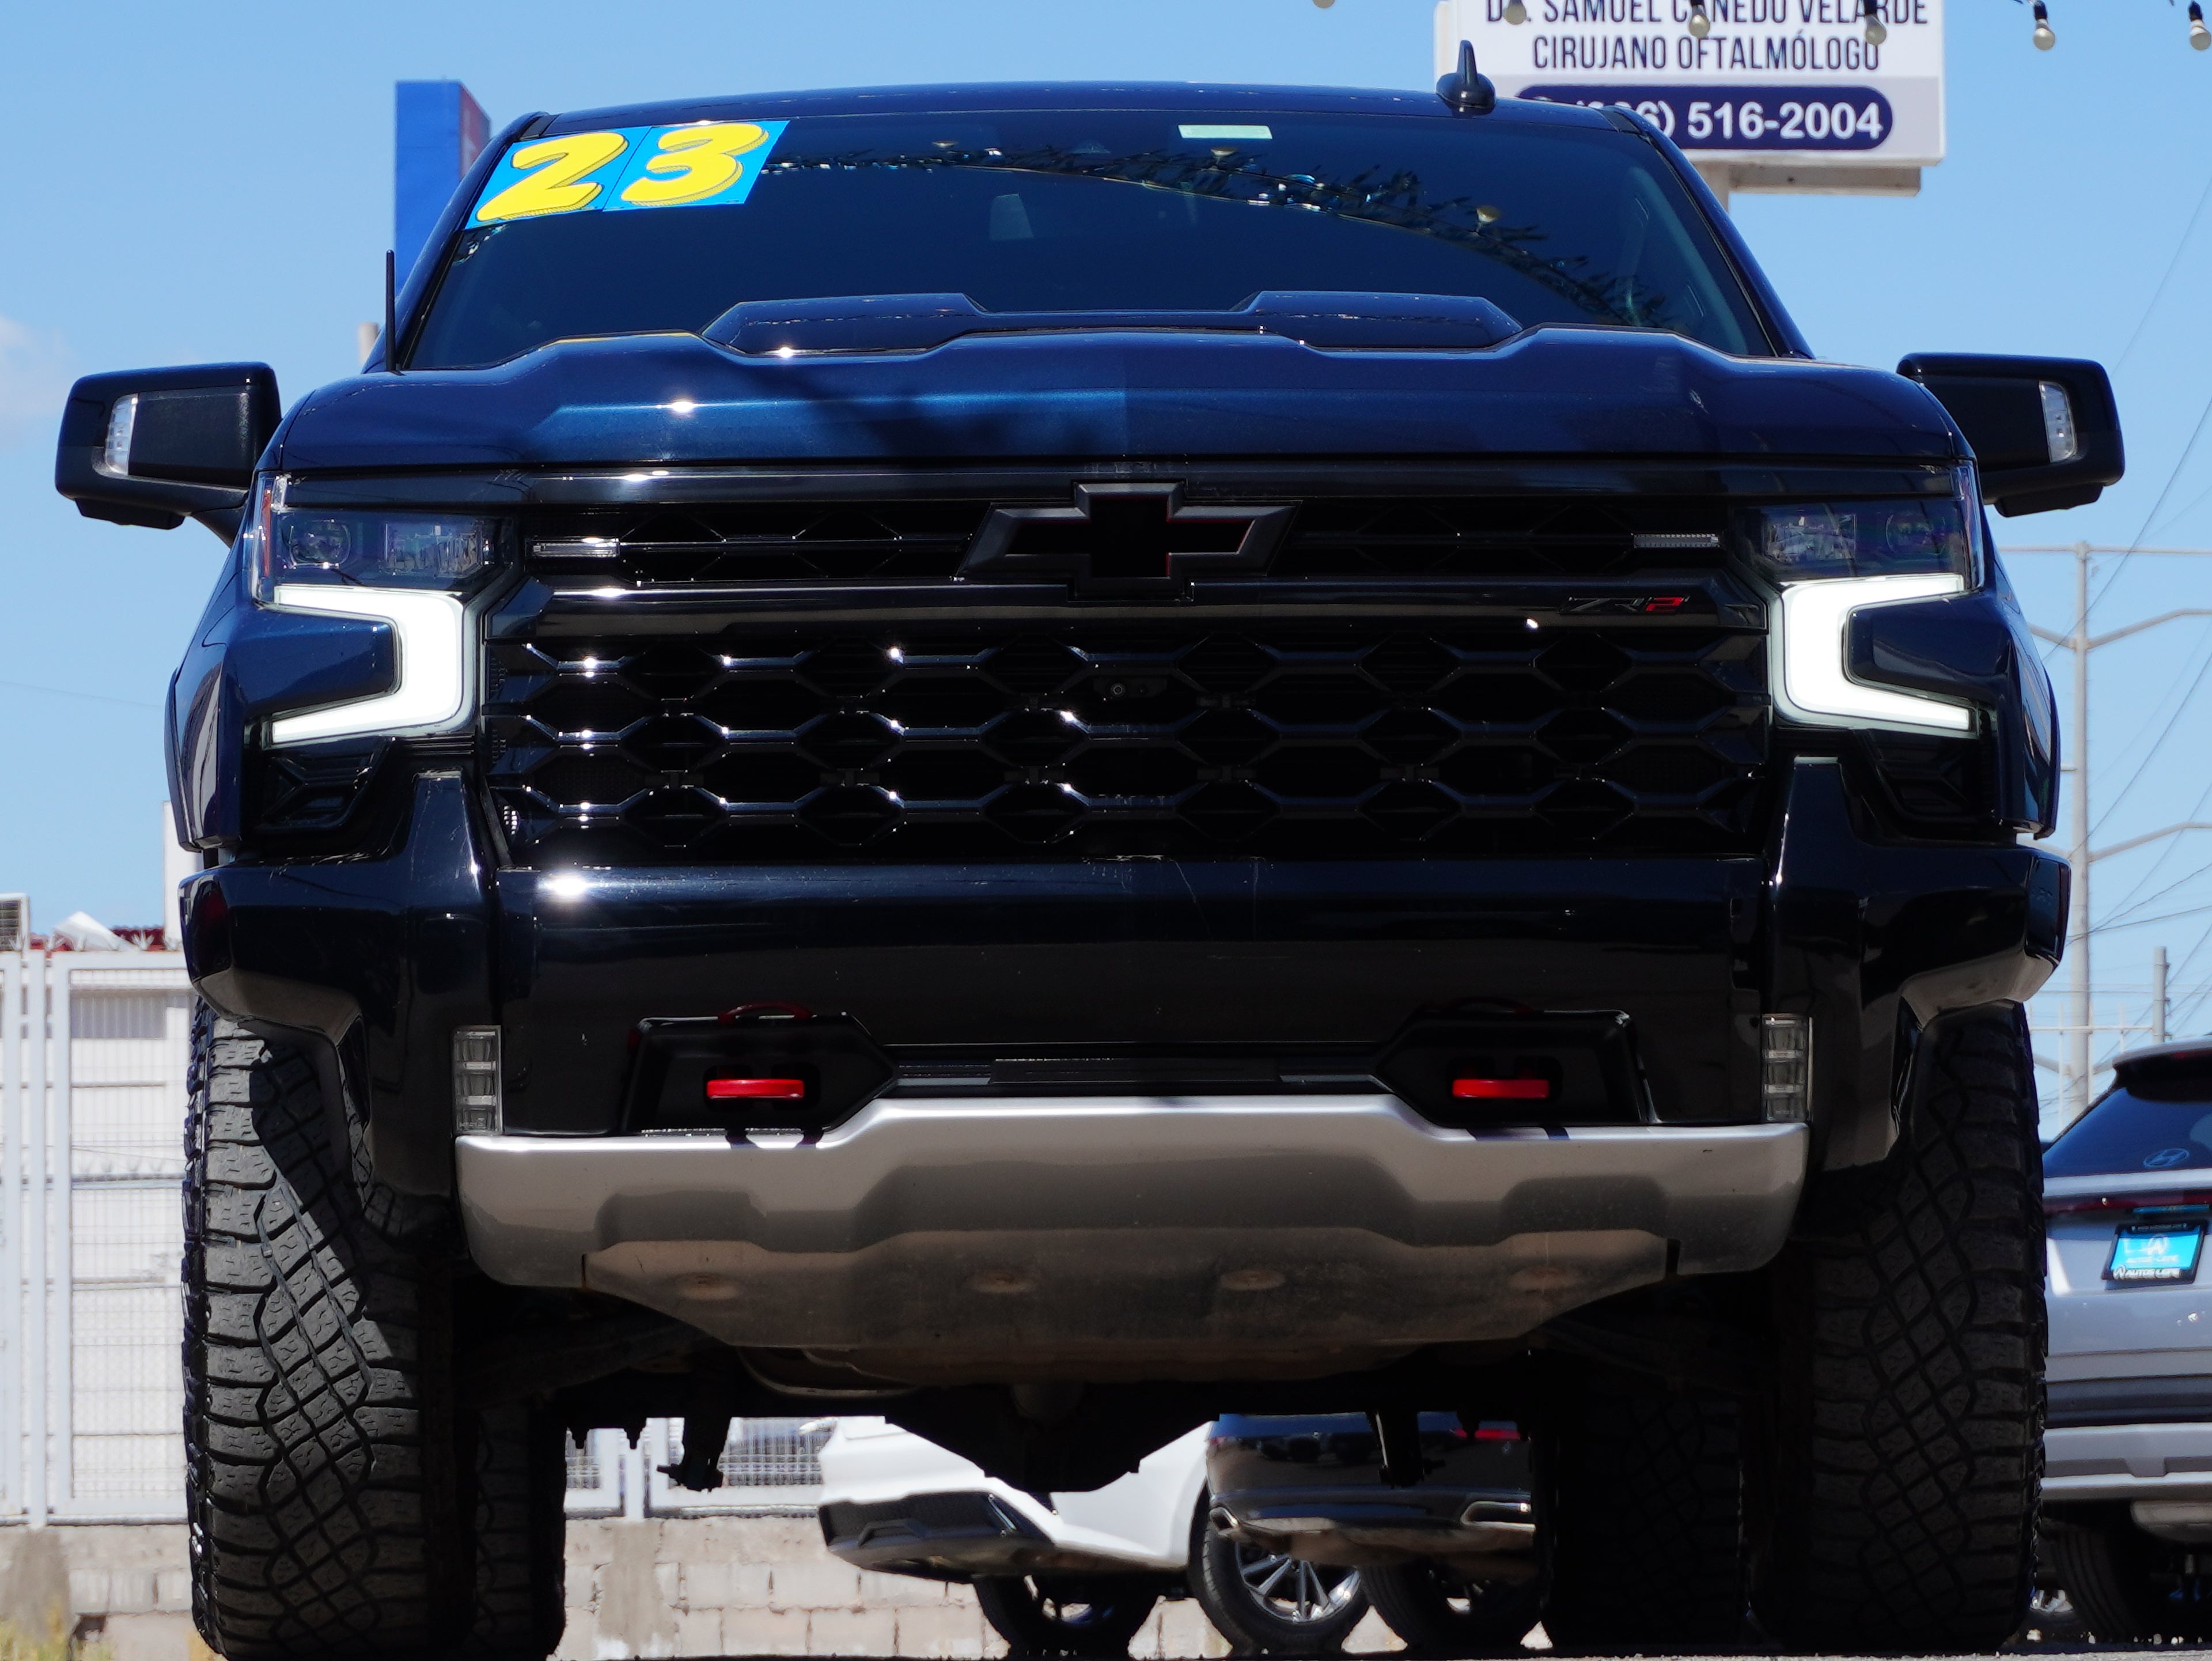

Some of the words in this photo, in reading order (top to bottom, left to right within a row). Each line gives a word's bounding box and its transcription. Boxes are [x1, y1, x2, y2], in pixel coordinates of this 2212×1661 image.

[1486, 0, 1532, 22] D.
[1544, 0, 1662, 22] SAMUEL
[1672, 0, 1787, 22] CNEDO
[1532, 35, 1666, 69] CIRUJANO
[1677, 29, 1880, 70] OFTALMÓLOGO
[1687, 101, 1884, 139] 516-2004
